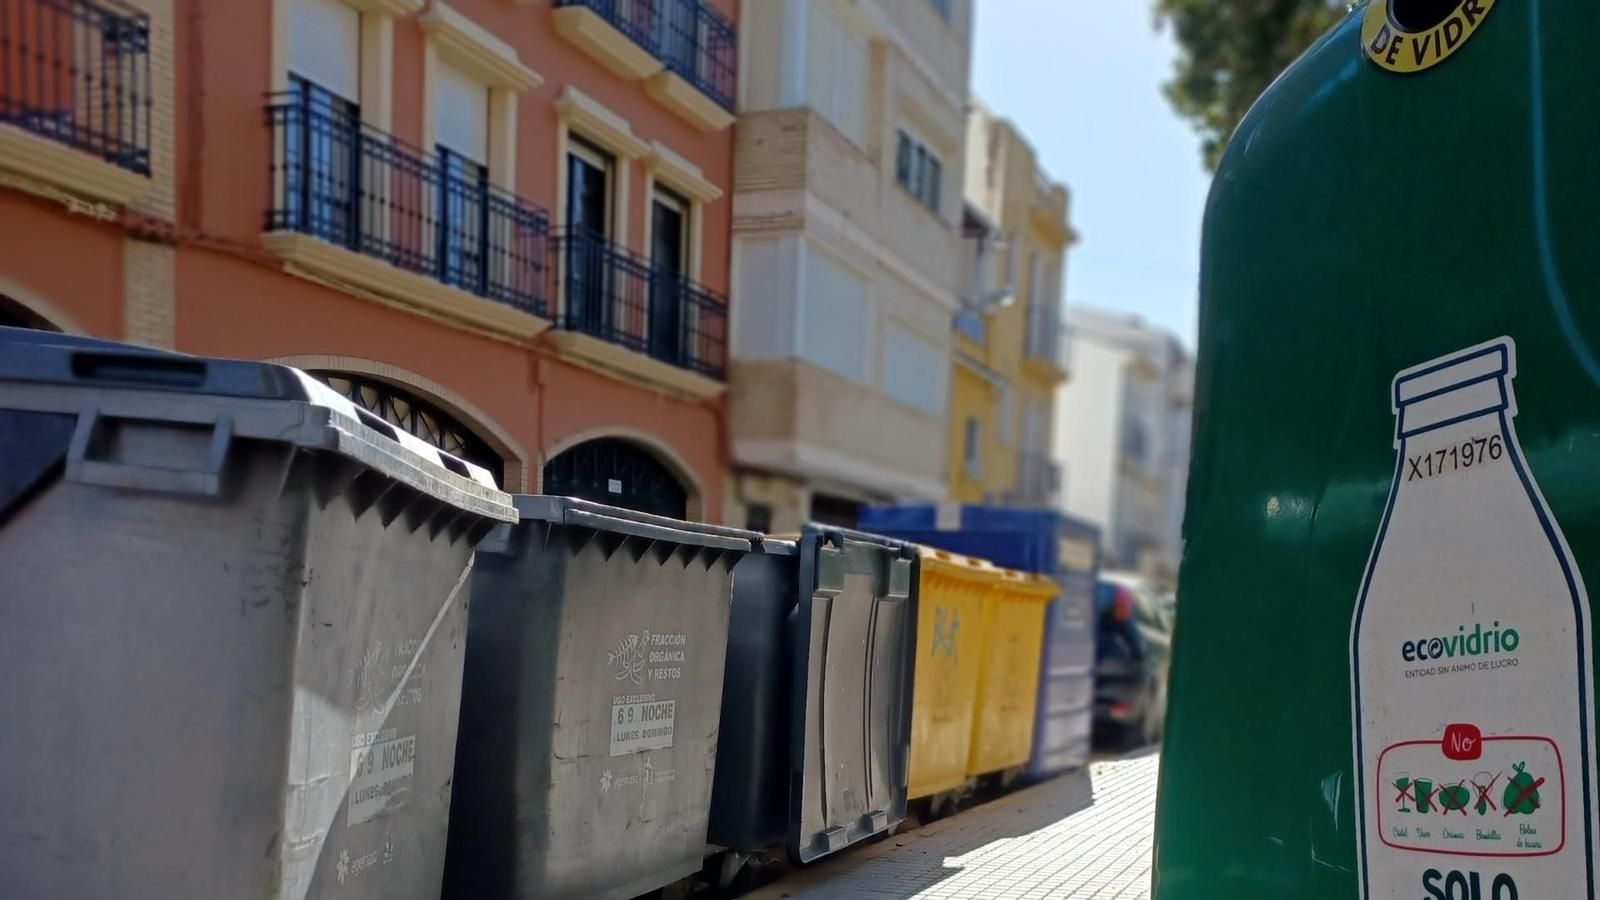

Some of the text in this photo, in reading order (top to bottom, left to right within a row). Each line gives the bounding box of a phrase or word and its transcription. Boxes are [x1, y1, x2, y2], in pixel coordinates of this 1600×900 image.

[1370, 24, 1405, 66] DE
[1408, 434, 1503, 481] X171976
[1402, 621, 1520, 662] ecovidrio
[647, 668, 681, 680] Y RESTOS
[1404, 668, 1436, 679] ENTIDAD
[1437, 666, 1450, 675] SIN
[1478, 662, 1489, 671] DE
[1491, 658, 1519, 669] LUCRO
[613, 693, 656, 705] USO EXCLUSIVO
[641, 703, 673, 722] NOCHE
[352, 734, 365, 747] USO
[617, 726, 672, 742] LUNES DOMINGO
[1450, 731, 1476, 752] No
[382, 740, 414, 770] NOCHE
[1422, 868, 1519, 900] SOLO
